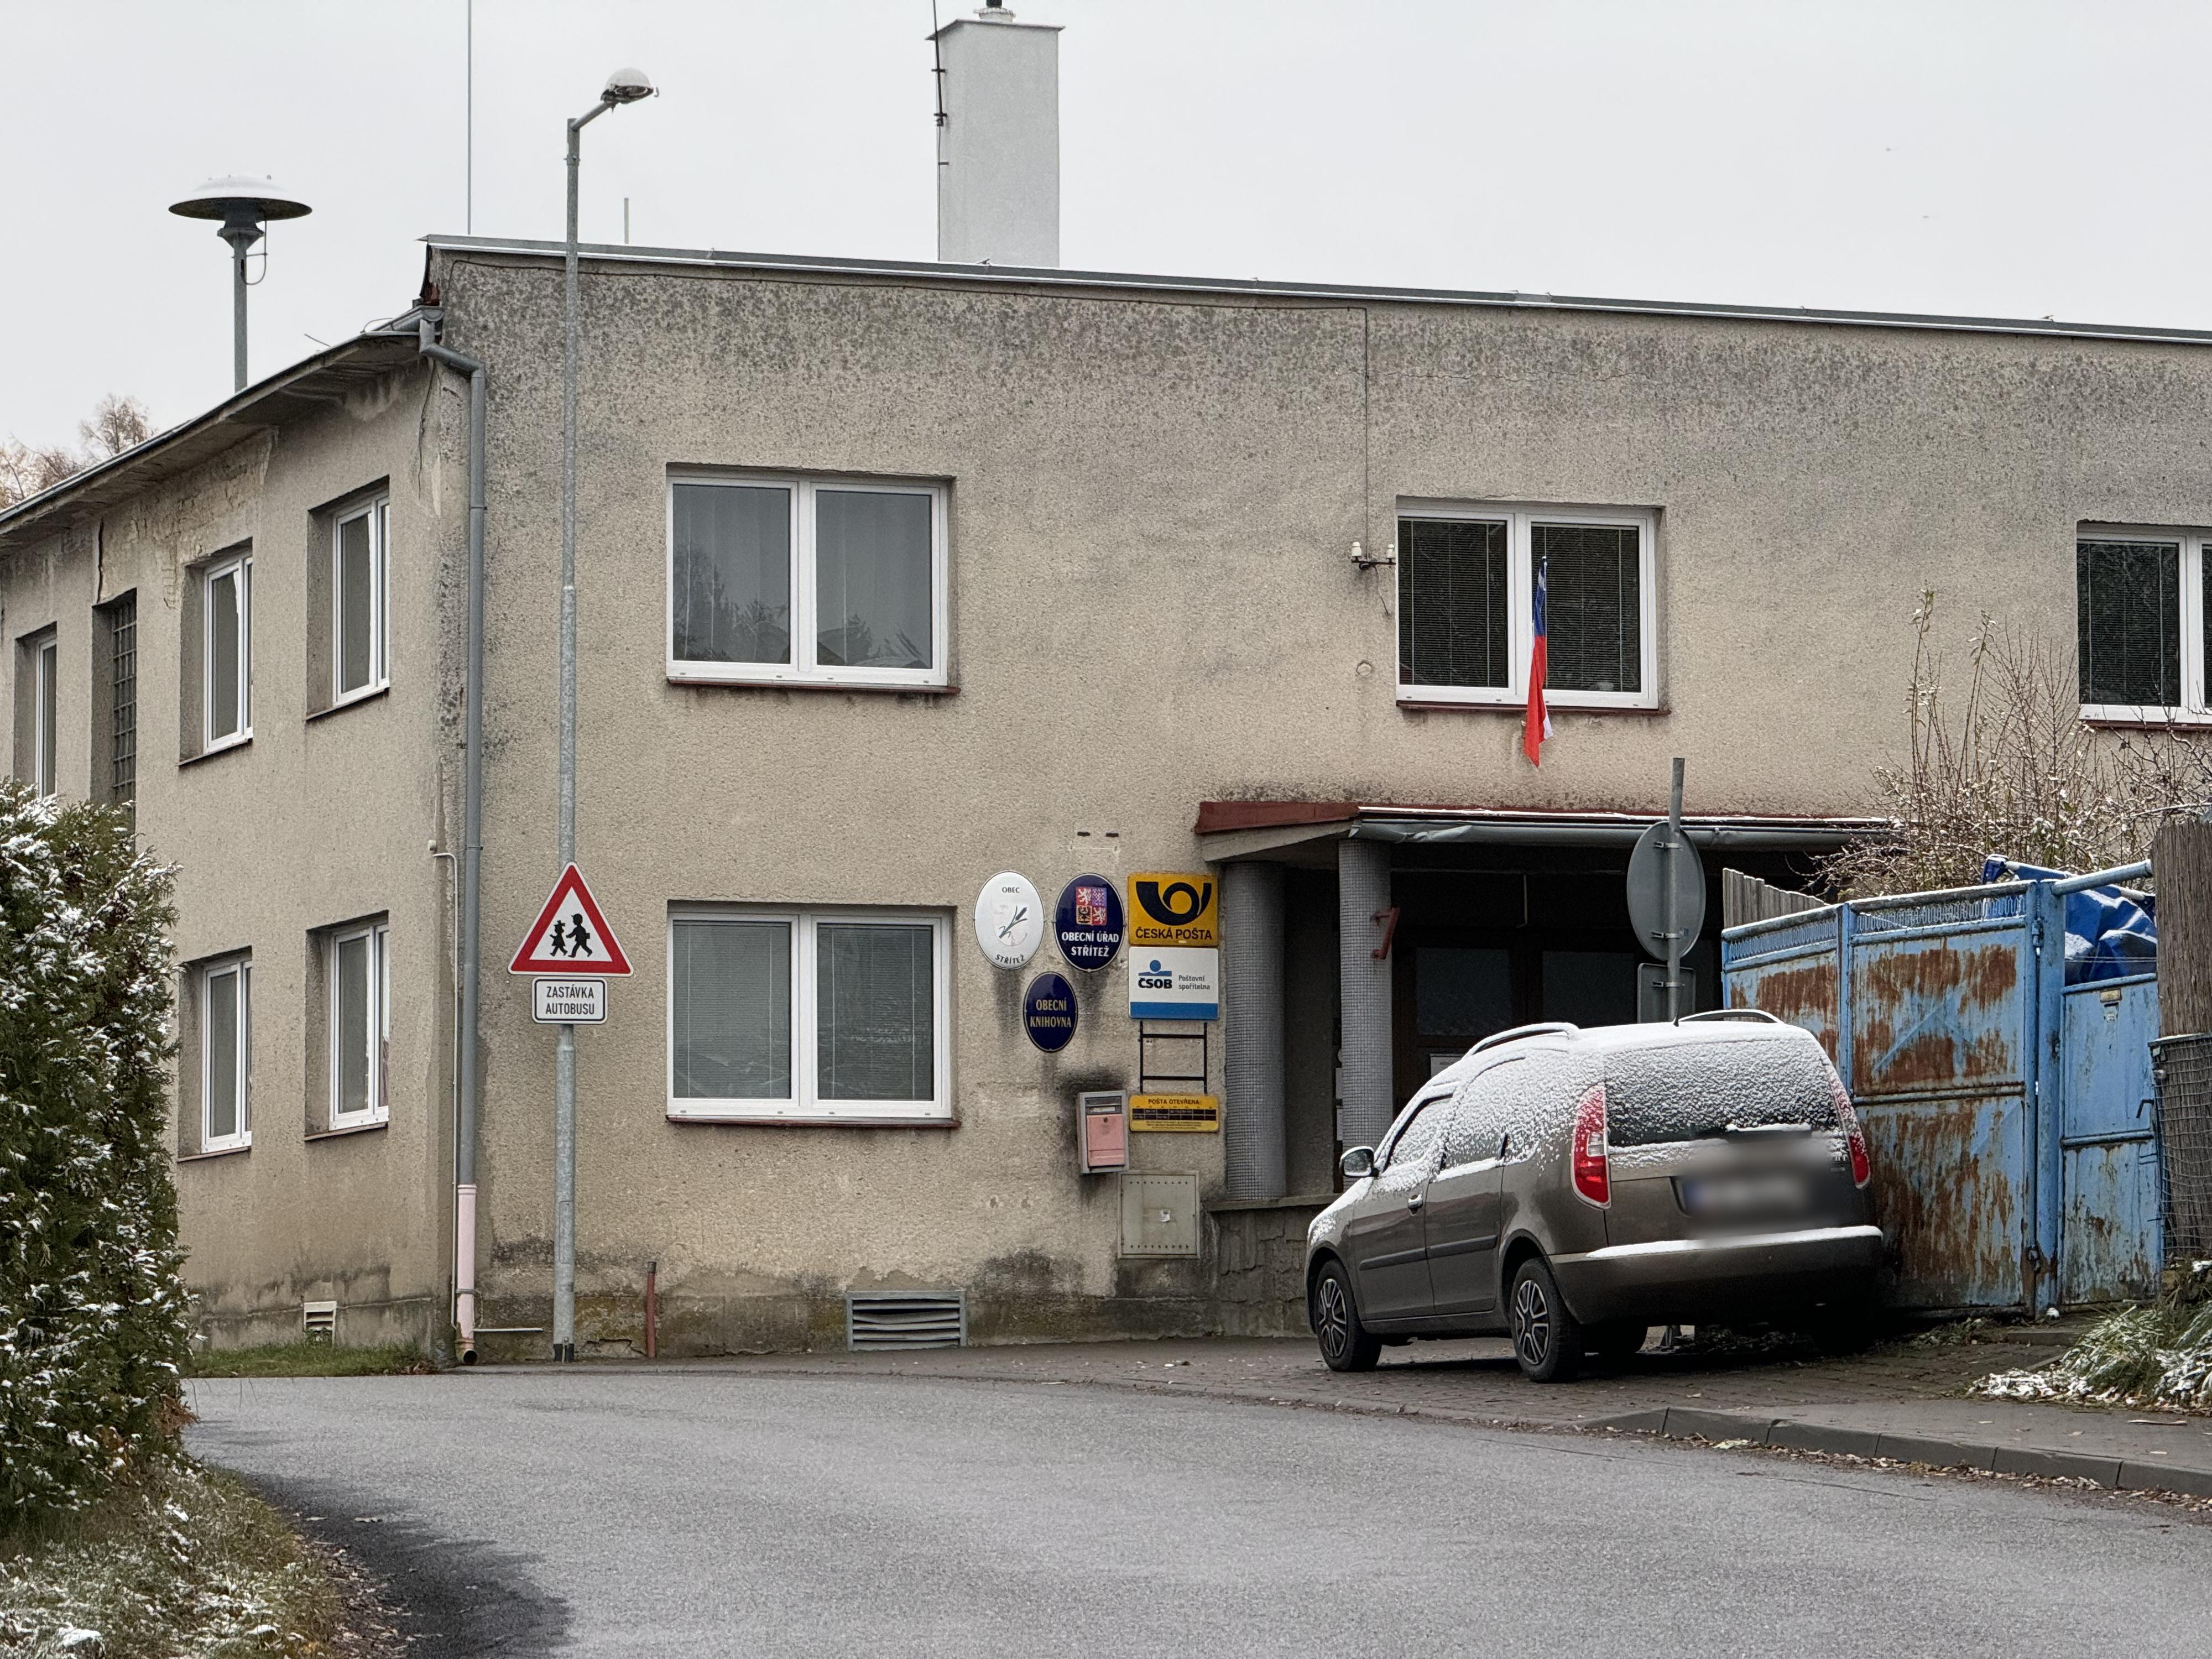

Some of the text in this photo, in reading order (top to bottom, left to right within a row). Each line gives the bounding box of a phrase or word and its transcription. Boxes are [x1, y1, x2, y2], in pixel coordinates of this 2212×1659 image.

[1061, 930, 1119, 943] OBECNÍ ÚŘAD
[1135, 926, 1212, 940] ČESKÁ POŠTA
[1071, 945, 1109, 957] STŘÍTEŽ
[995, 954, 1025, 964] STŘÍTEŽ
[1138, 977, 1172, 989] ČSOB
[546, 984, 594, 999] ZASTÁVKA
[545, 1003, 594, 1015] AUTOBUSU
[1036, 997, 1067, 1011] OBECNÍ
[1030, 1016, 1072, 1028] KNIHOVNA
